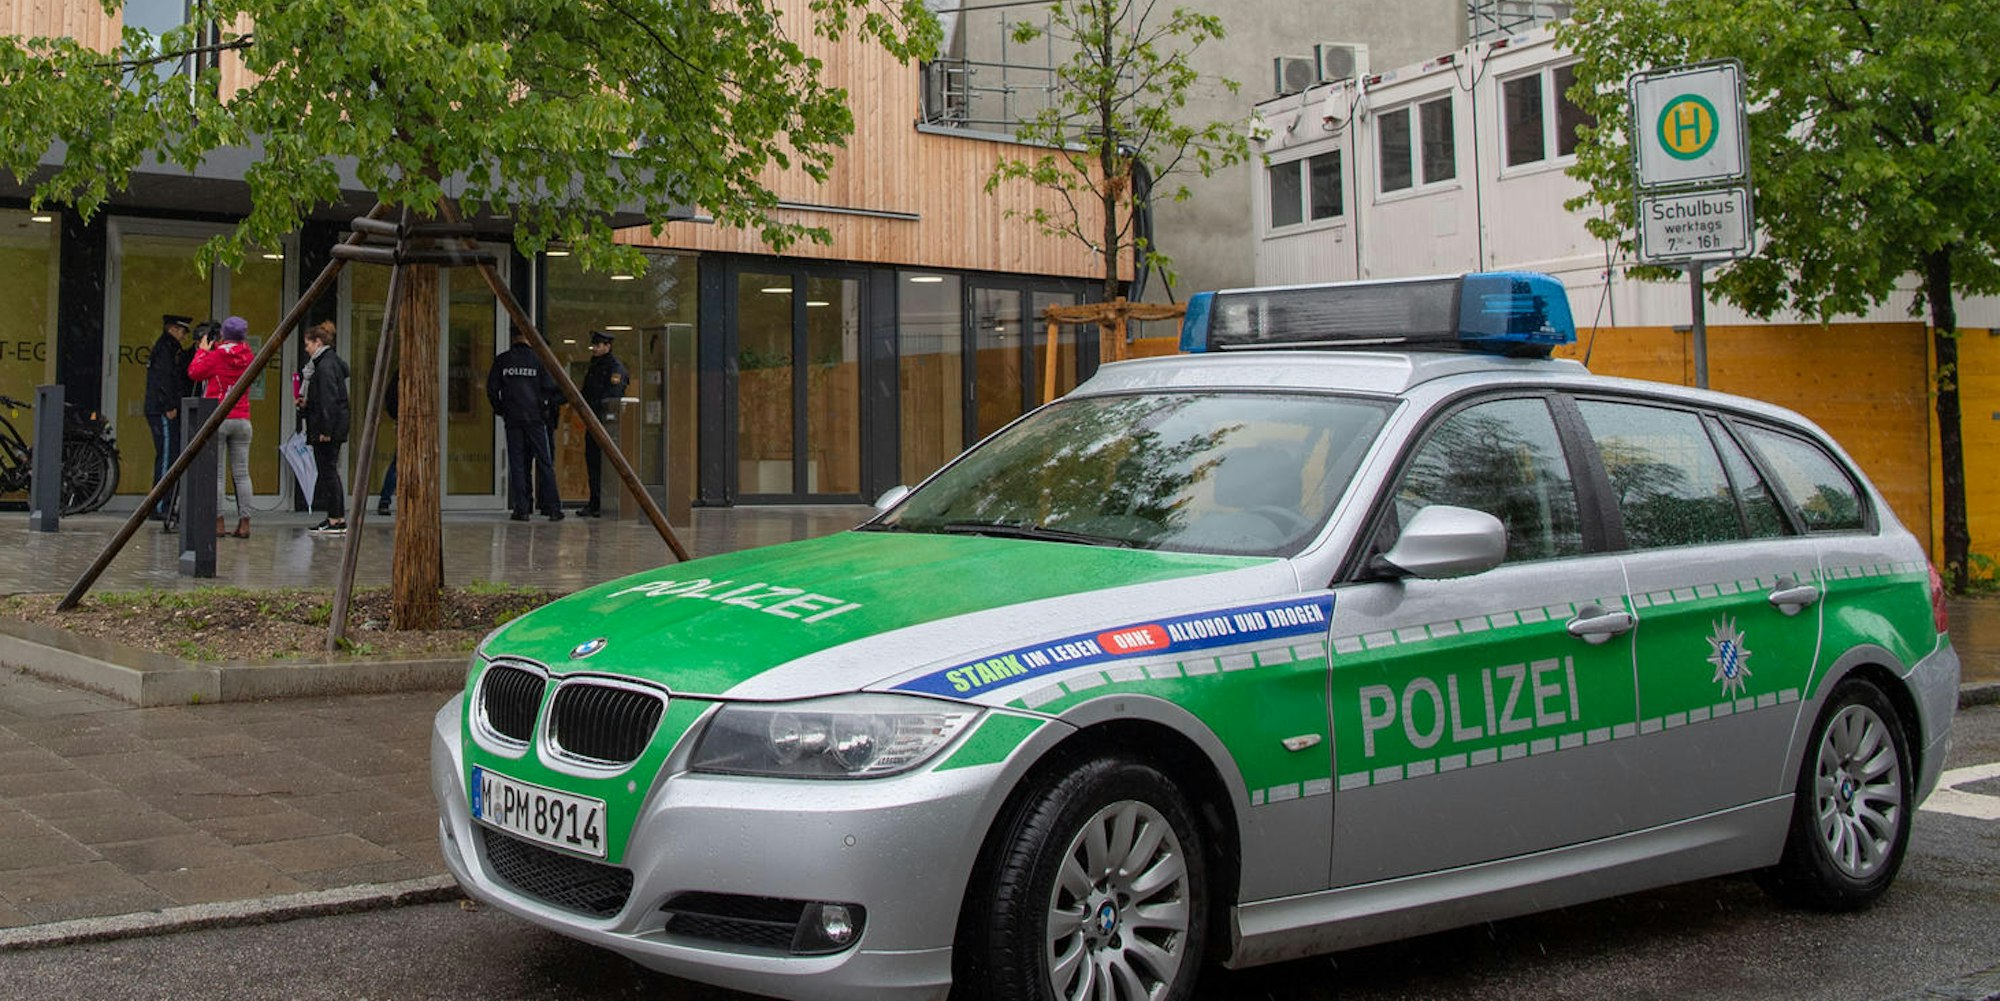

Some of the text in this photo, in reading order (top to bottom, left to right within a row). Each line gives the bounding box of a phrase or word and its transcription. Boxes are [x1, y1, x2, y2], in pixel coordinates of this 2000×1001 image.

[1674, 107, 1701, 147] H
[1652, 199, 1735, 220] Schulbus
[1664, 220, 1723, 235] werktags
[502, 367, 538, 377] POLIZEI
[607, 579, 863, 624] POLIZEI
[945, 603, 1325, 693] STARK IM LEBEN OHNE ALKOHOL UND DROGEN
[1359, 655, 1580, 758] POLIZEI
[481, 776, 492, 817] M
